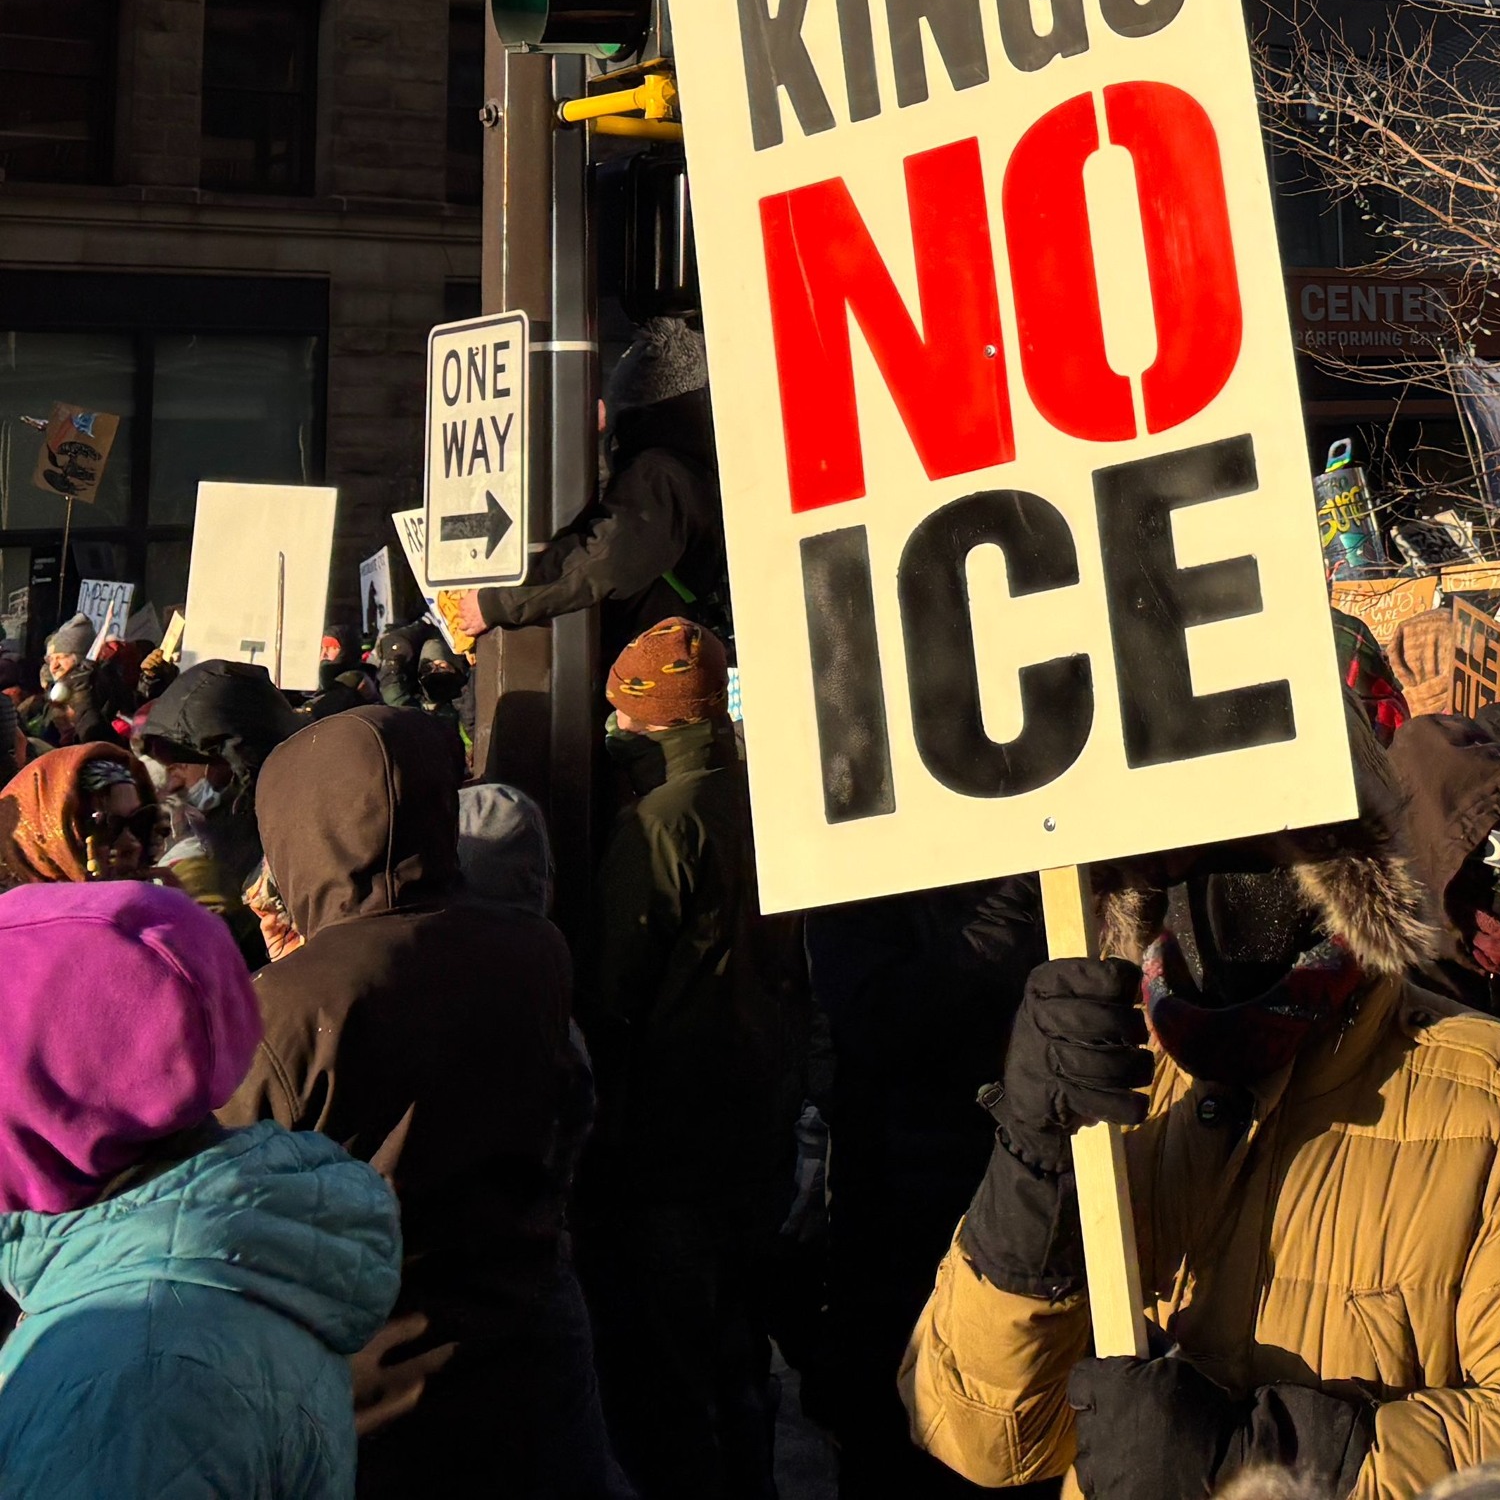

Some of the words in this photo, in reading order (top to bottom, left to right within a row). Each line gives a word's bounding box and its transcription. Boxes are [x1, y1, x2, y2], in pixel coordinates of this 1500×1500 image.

[758, 79, 1244, 514] NO
[1300, 284, 1450, 322] CENTER
[1297, 330, 1403, 347] PERFORMING
[441, 340, 512, 406] ONE
[442, 411, 514, 480] WAY
[799, 433, 1296, 825] ICE
